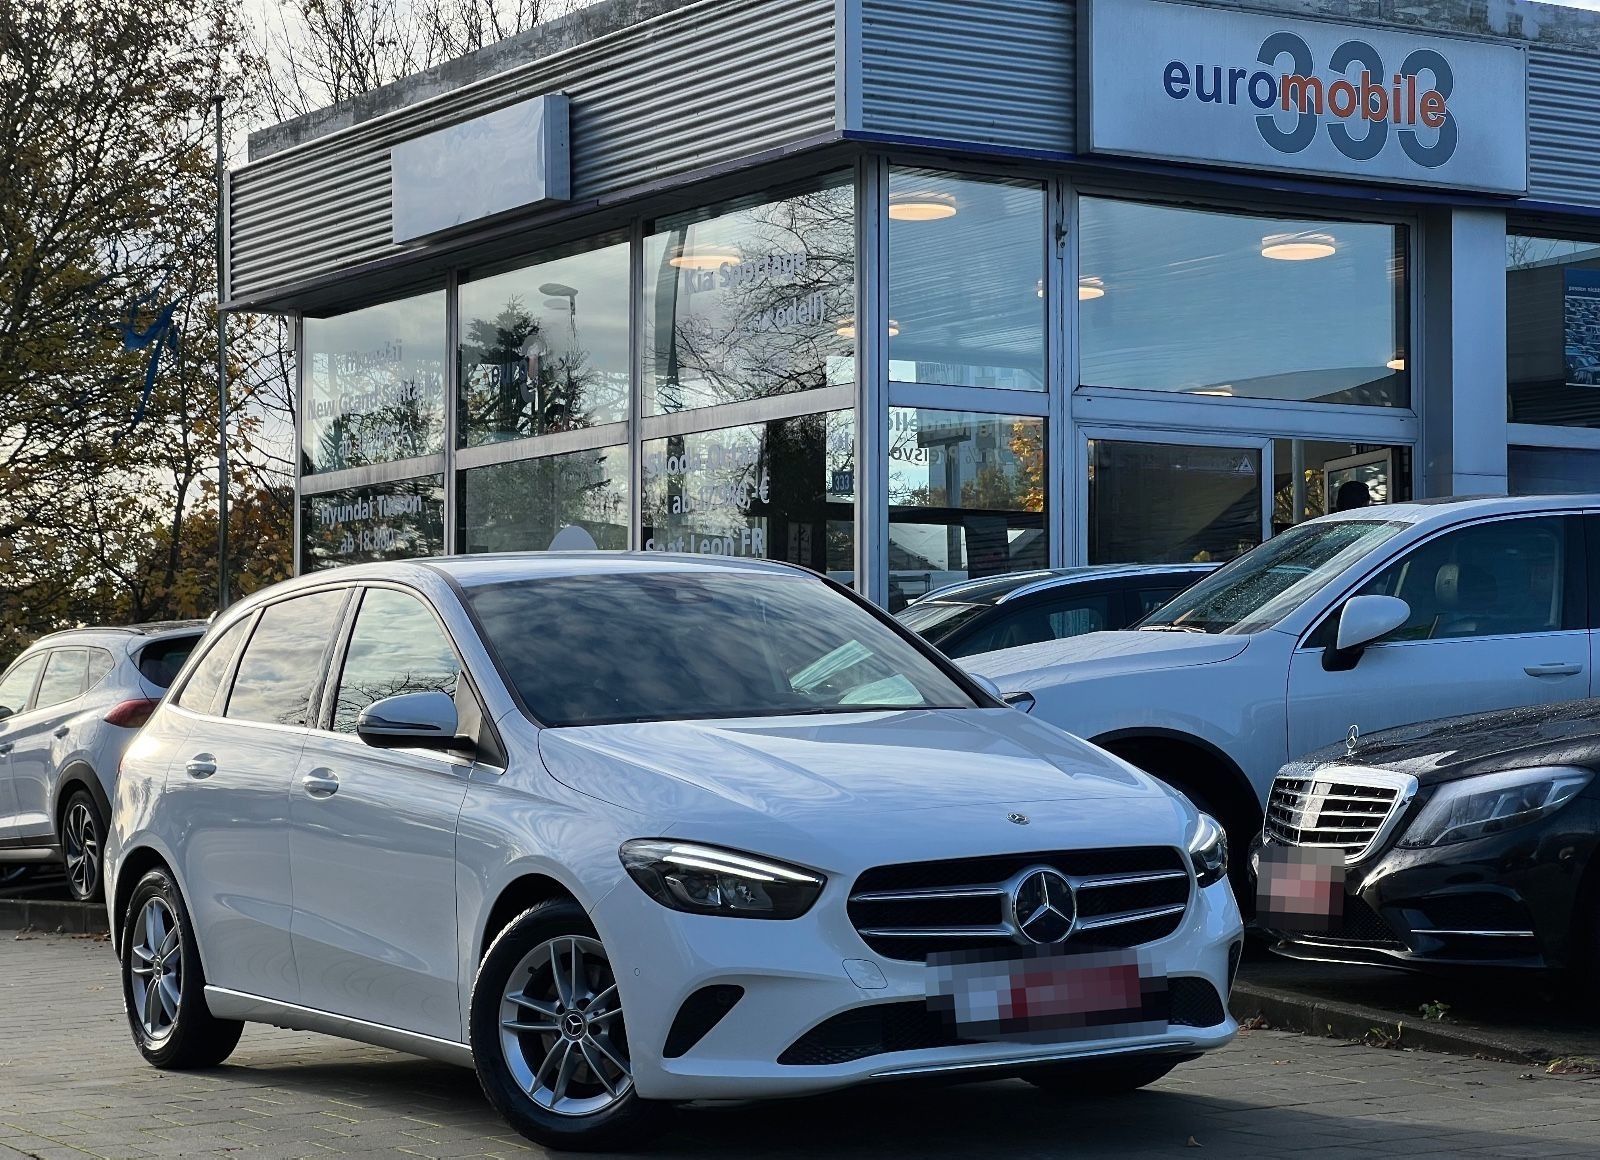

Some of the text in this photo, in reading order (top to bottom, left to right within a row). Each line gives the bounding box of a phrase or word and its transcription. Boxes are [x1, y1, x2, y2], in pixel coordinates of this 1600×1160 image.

[1163, 58, 1447, 128] euromobile
[684, 249, 808, 296] Kia Sportage
[307, 398, 336, 420] New
[321, 496, 373, 529] Hyundai
[340, 531, 354, 554] ab
[740, 526, 764, 556] FR
